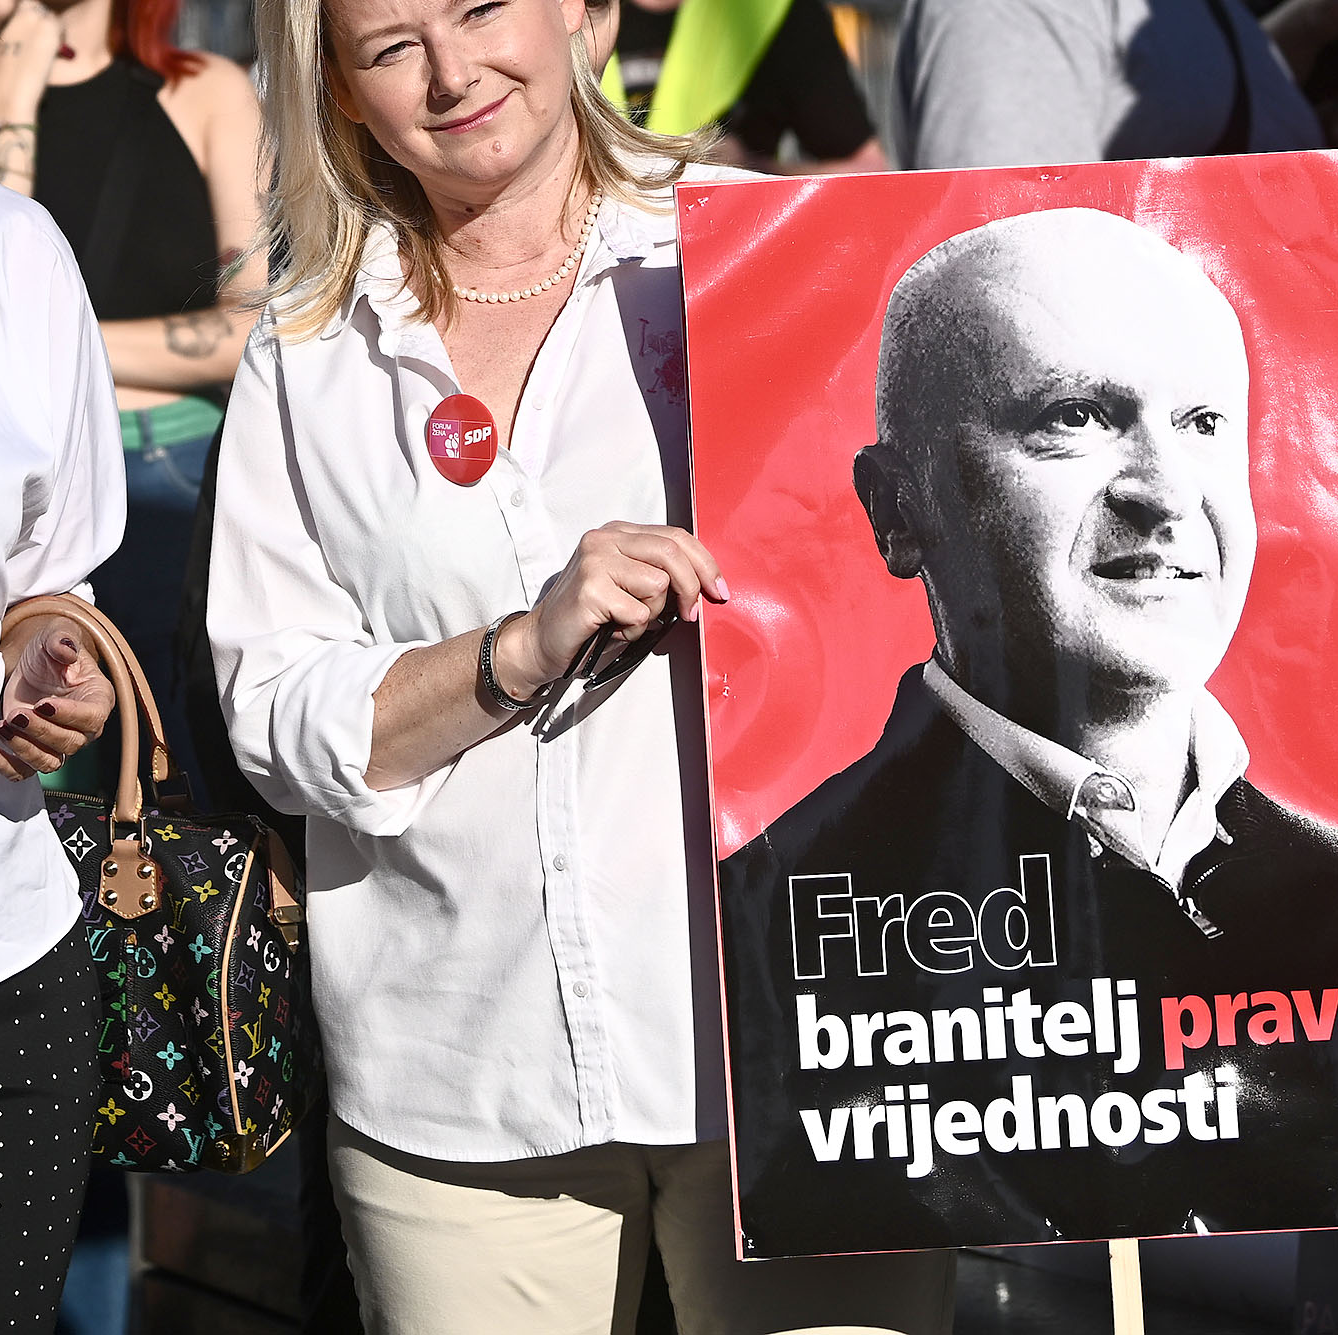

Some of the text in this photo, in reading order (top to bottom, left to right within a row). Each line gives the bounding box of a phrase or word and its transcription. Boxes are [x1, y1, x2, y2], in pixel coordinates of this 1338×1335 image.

[432, 422, 452, 430] FORUM
[464, 426, 492, 446] SDP
[787, 853, 1058, 981] Fred
[795, 974, 1141, 1074] branitelj
[798, 1066, 1241, 1179] vrijednosti
